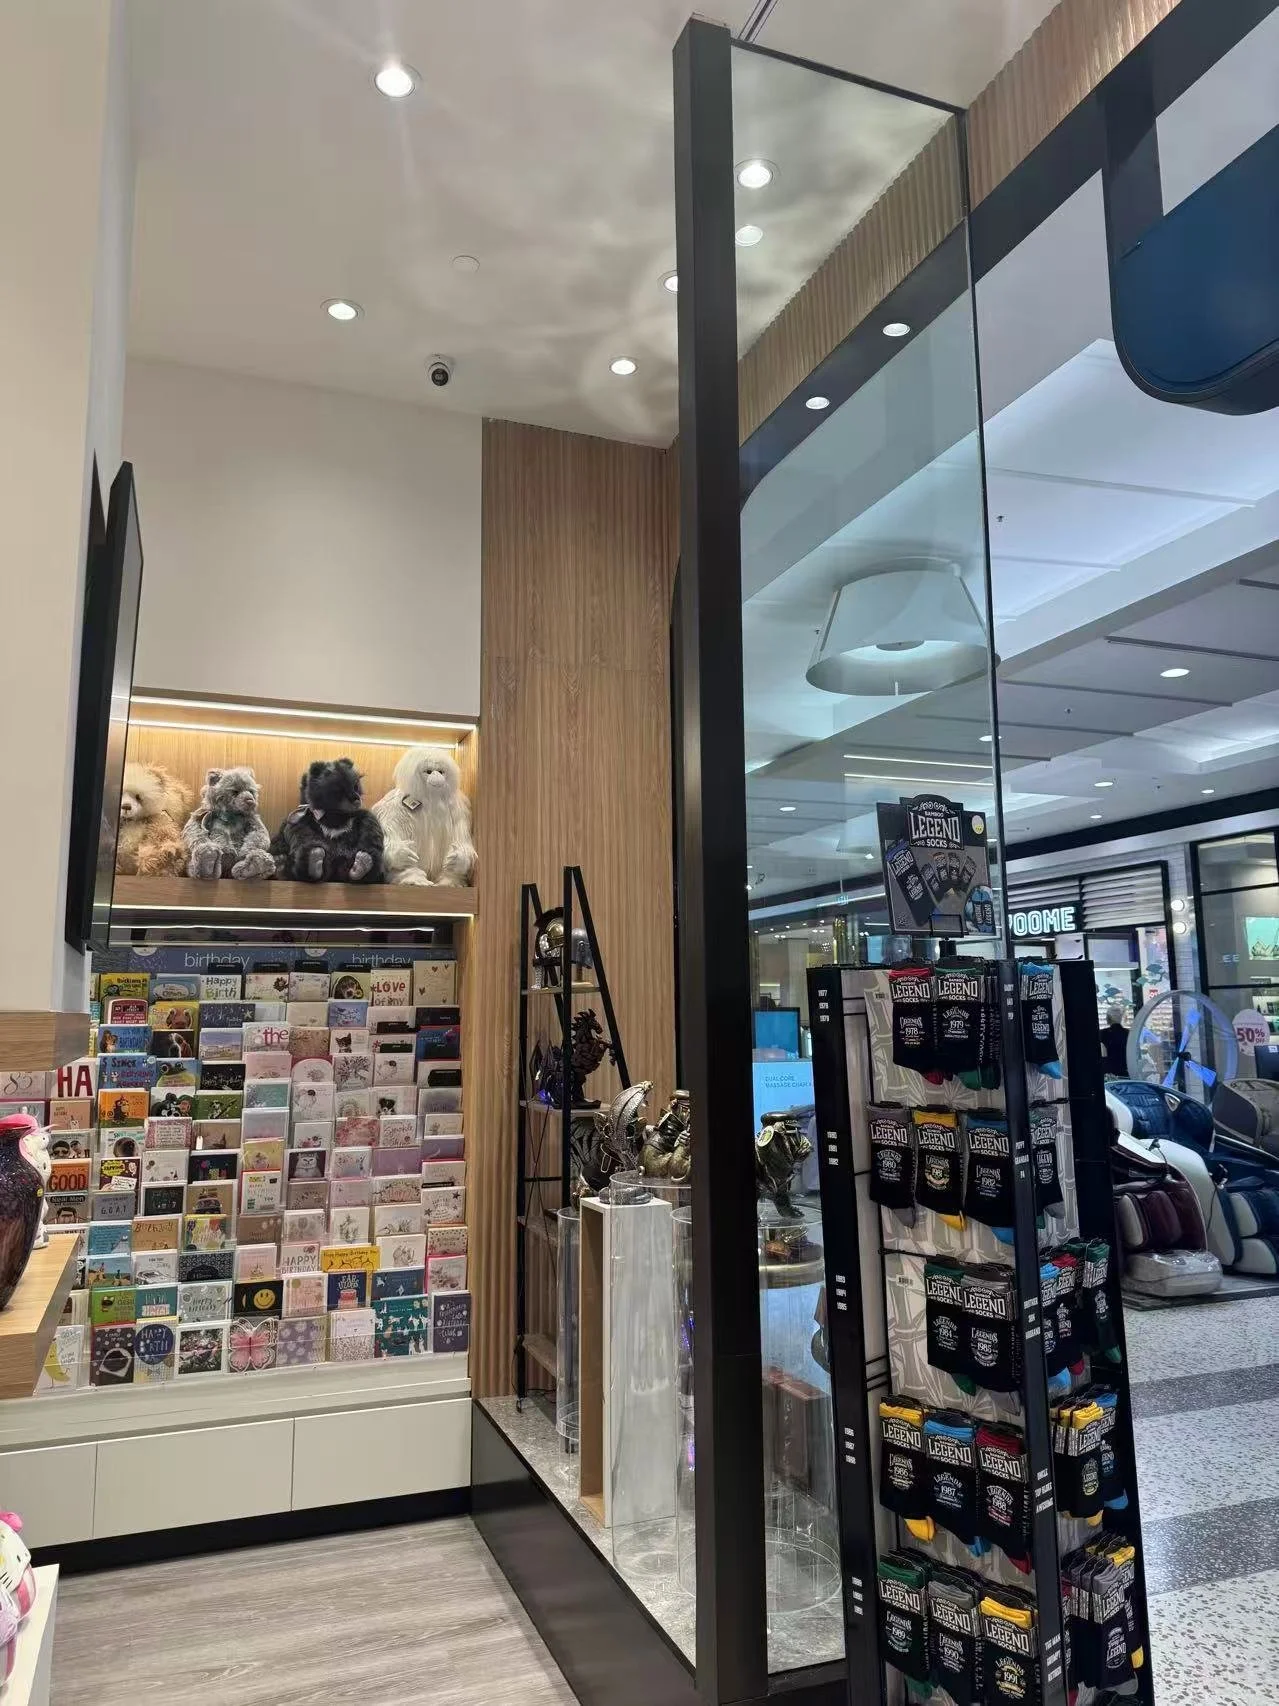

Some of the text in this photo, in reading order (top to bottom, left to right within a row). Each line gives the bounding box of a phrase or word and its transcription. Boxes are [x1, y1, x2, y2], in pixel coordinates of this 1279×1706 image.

[909, 812, 960, 842] LEGEND
[926, 840, 948, 848] SOCKS
[184, 952, 250, 970] birthday
[352, 954, 411, 967] birthday
[891, 982, 930, 998] LEGEND
[938, 979, 978, 998] LEGEND
[1030, 980, 1052, 996] LEGEND
[950, 1020, 964, 1029] 1979
[262, 1027, 289, 1046] the
[57, 1065, 94, 1098] HA
[870, 1124, 908, 1144] LEGEND
[918, 1129, 956, 1148] LEGEND
[968, 1132, 1010, 1154] LEGEND
[882, 1160, 896, 1168] 1980
[48, 1174, 87, 1192] GOOD
[982, 1177, 996, 1187] 1982
[282, 1256, 316, 1266] HAPPY
[282, 1266, 316, 1274] BIRTHDAY
[937, 1296, 954, 1304] SOCKS
[964, 1291, 1006, 1316] LEGEND
[975, 1310, 994, 1318] SOCKS
[978, 1342, 992, 1353] 1985
[882, 1422, 922, 1448] LEGEND
[893, 1440, 910, 1448] SOCKS
[928, 1438, 972, 1464] LEGEND
[940, 1457, 960, 1466] SOCKS
[980, 1450, 1022, 1478] LEGEND
[894, 1466, 908, 1476] 1986
[992, 1469, 1010, 1480] SOCKS
[941, 1486, 956, 1496] 1987
[992, 1496, 1006, 1511] 1988
[880, 1580, 920, 1610] LEGEND
[892, 1600, 910, 1610] SOCKS
[931, 1600, 971, 1632] LEGEND
[892, 1626, 906, 1640] 1989
[942, 1620, 960, 1632] SOCKS
[984, 1618, 1030, 1652] LEGEND
[944, 1646, 959, 1660] 1990
[998, 1640, 1017, 1652] SOCKS
[1004, 1672, 1018, 1684] 1991
